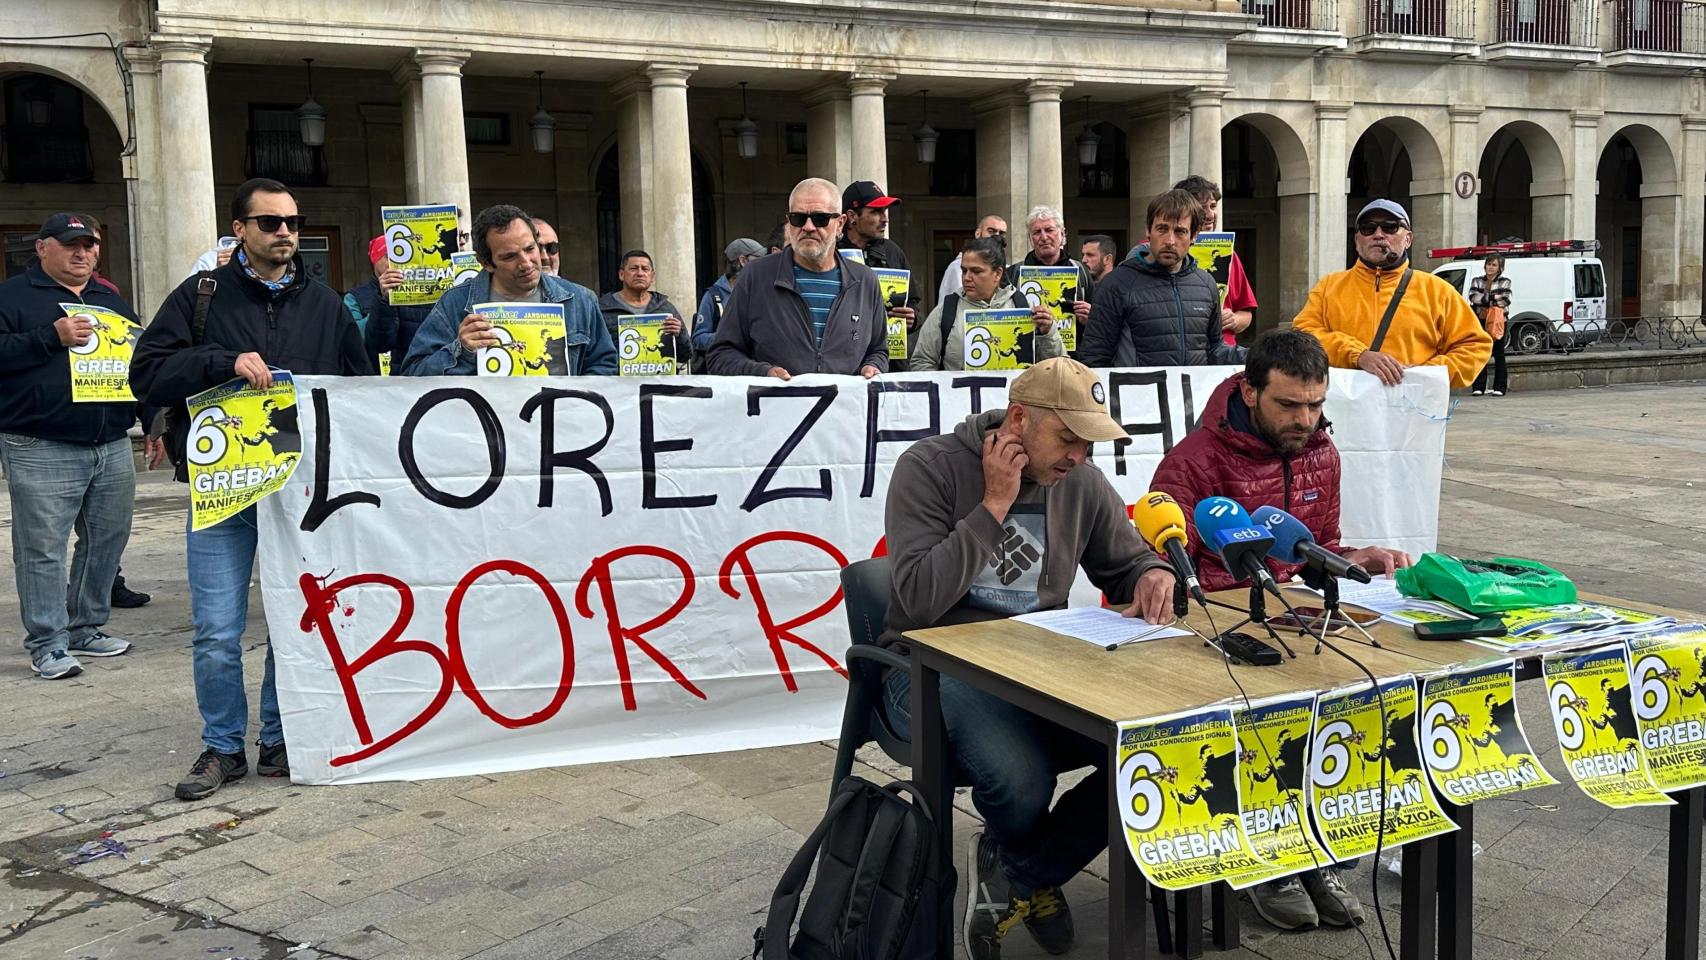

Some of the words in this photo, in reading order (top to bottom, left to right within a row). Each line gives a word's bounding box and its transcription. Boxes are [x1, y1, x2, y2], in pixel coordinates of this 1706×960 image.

[385, 223, 414, 264] 6
[400, 267, 454, 280] REBAN
[392, 283, 454, 293] MANIFESTAZIO
[477, 325, 514, 376] 6
[619, 327, 641, 360] 6
[965, 326, 991, 368] 6
[74, 359, 129, 374] GREB
[622, 362, 672, 374] GREBAN
[74, 378, 129, 387] MANIFESTA
[187, 405, 229, 466] 6
[194, 460, 292, 494] GREBAN
[1233, 528, 1261, 540] etb
[299, 531, 888, 767] BORR
[1582, 657, 1623, 669] JARDINERIA
[1452, 684, 1489, 696] CONDICIONES
[1490, 681, 1510, 689] DIGNAS
[1467, 671, 1510, 685] JARDINERIA
[1633, 654, 1670, 721] 6
[1263, 705, 1310, 720] JARDINERIA
[1323, 695, 1365, 715] enviser
[1335, 709, 1352, 718] UNAS
[1353, 699, 1393, 715] CONDICIOES
[1393, 695, 1414, 705] DIGNAS
[1550, 680, 1585, 751] 6
[1126, 723, 1174, 743] enviser
[1178, 719, 1231, 734] JARDINERIA
[1286, 716, 1309, 725] DIGNAS
[1124, 742, 1138, 751] POR
[1140, 741, 1158, 750] UNAS
[1160, 735, 1204, 746] CONDICIONES
[1205, 731, 1231, 740] DIGNAS
[1421, 699, 1462, 773] 6
[1312, 719, 1354, 788] 6
[1571, 750, 1640, 780] GREBAN
[1649, 750, 1706, 770] MANIFES
[1119, 750, 1165, 832] 6
[1444, 764, 1542, 797] GREBAN
[1320, 781, 1424, 820] GREBAN
[1242, 801, 1299, 837] EBAN
[1326, 809, 1440, 842] MANIFESTAZIOA
[1350, 816, 1360, 825] 26
[1136, 823, 1209, 843] HILABETE
[1138, 827, 1242, 865] GREBAN
[1255, 836, 1313, 858] ESTAZIOA
[1152, 857, 1260, 883] MANIFESTAZIOA
